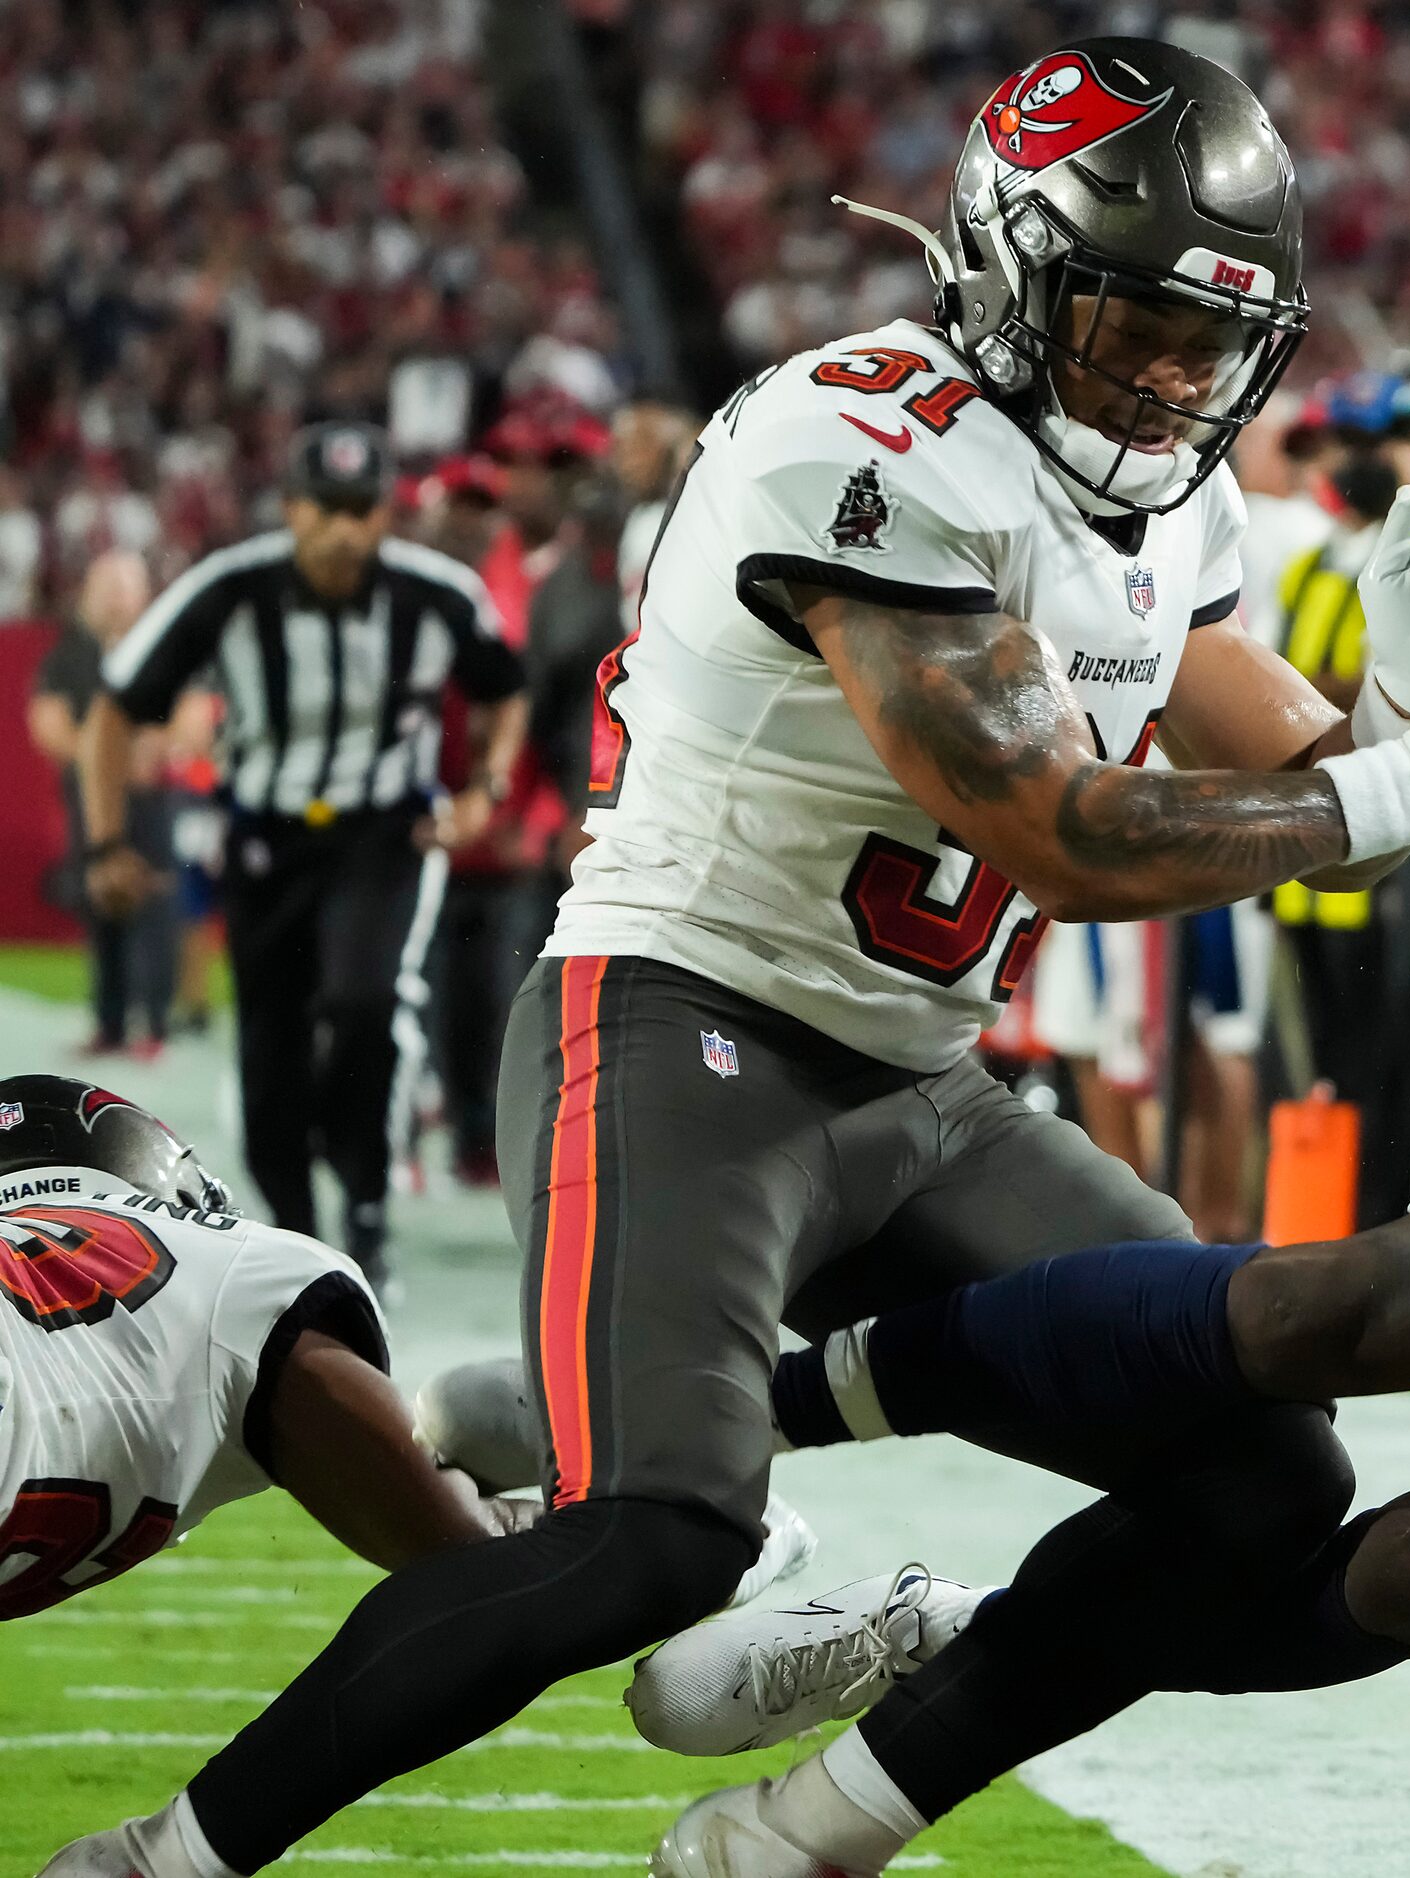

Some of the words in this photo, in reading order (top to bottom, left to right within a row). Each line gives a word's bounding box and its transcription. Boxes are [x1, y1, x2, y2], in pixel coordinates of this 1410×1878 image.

[1212, 259, 1256, 292] BUCS
[809, 347, 983, 437] 31
[1067, 650, 1161, 691] BUCCANEERS
[0, 1178, 81, 1206] HANGE
